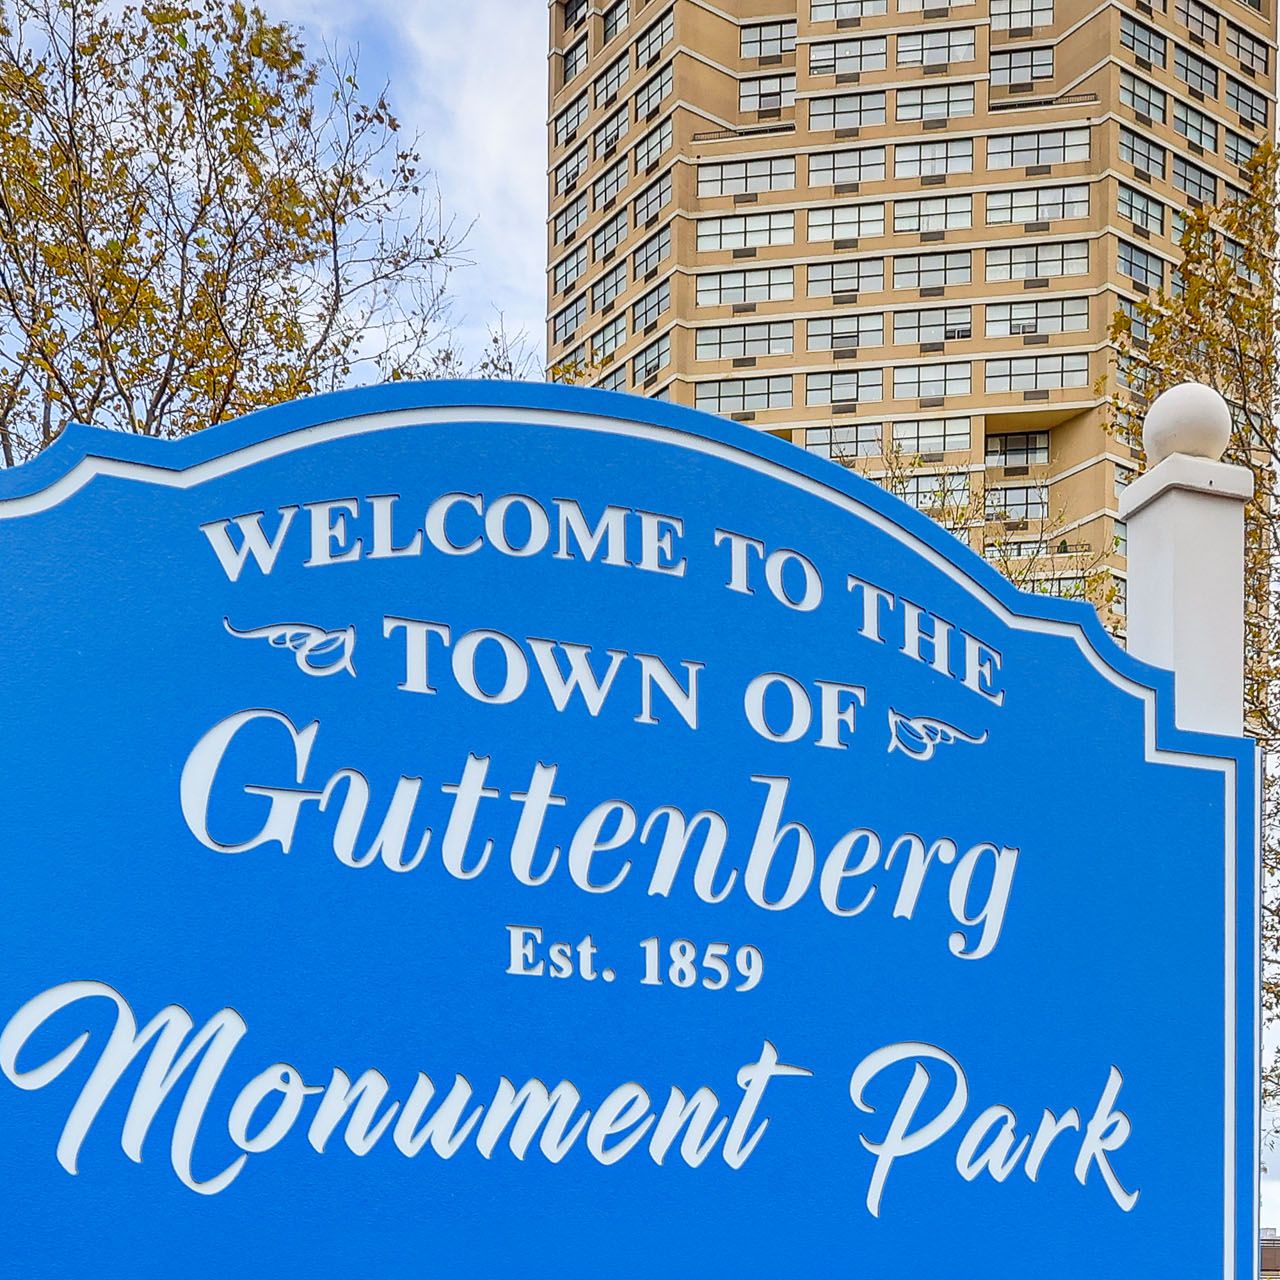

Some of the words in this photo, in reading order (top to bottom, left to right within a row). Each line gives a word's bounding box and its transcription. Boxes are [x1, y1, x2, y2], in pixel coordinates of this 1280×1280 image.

[198, 493, 687, 583] WELCOME
[713, 530, 823, 613] TO
[846, 575, 1005, 708] THE
[382, 616, 705, 731] TOWN
[743, 673, 866, 750] OF
[179, 709, 1020, 961] Guttenberg
[505, 925, 616, 984] Est.
[638, 937, 764, 993] 1859
[848, 1041, 1140, 1219] Park
